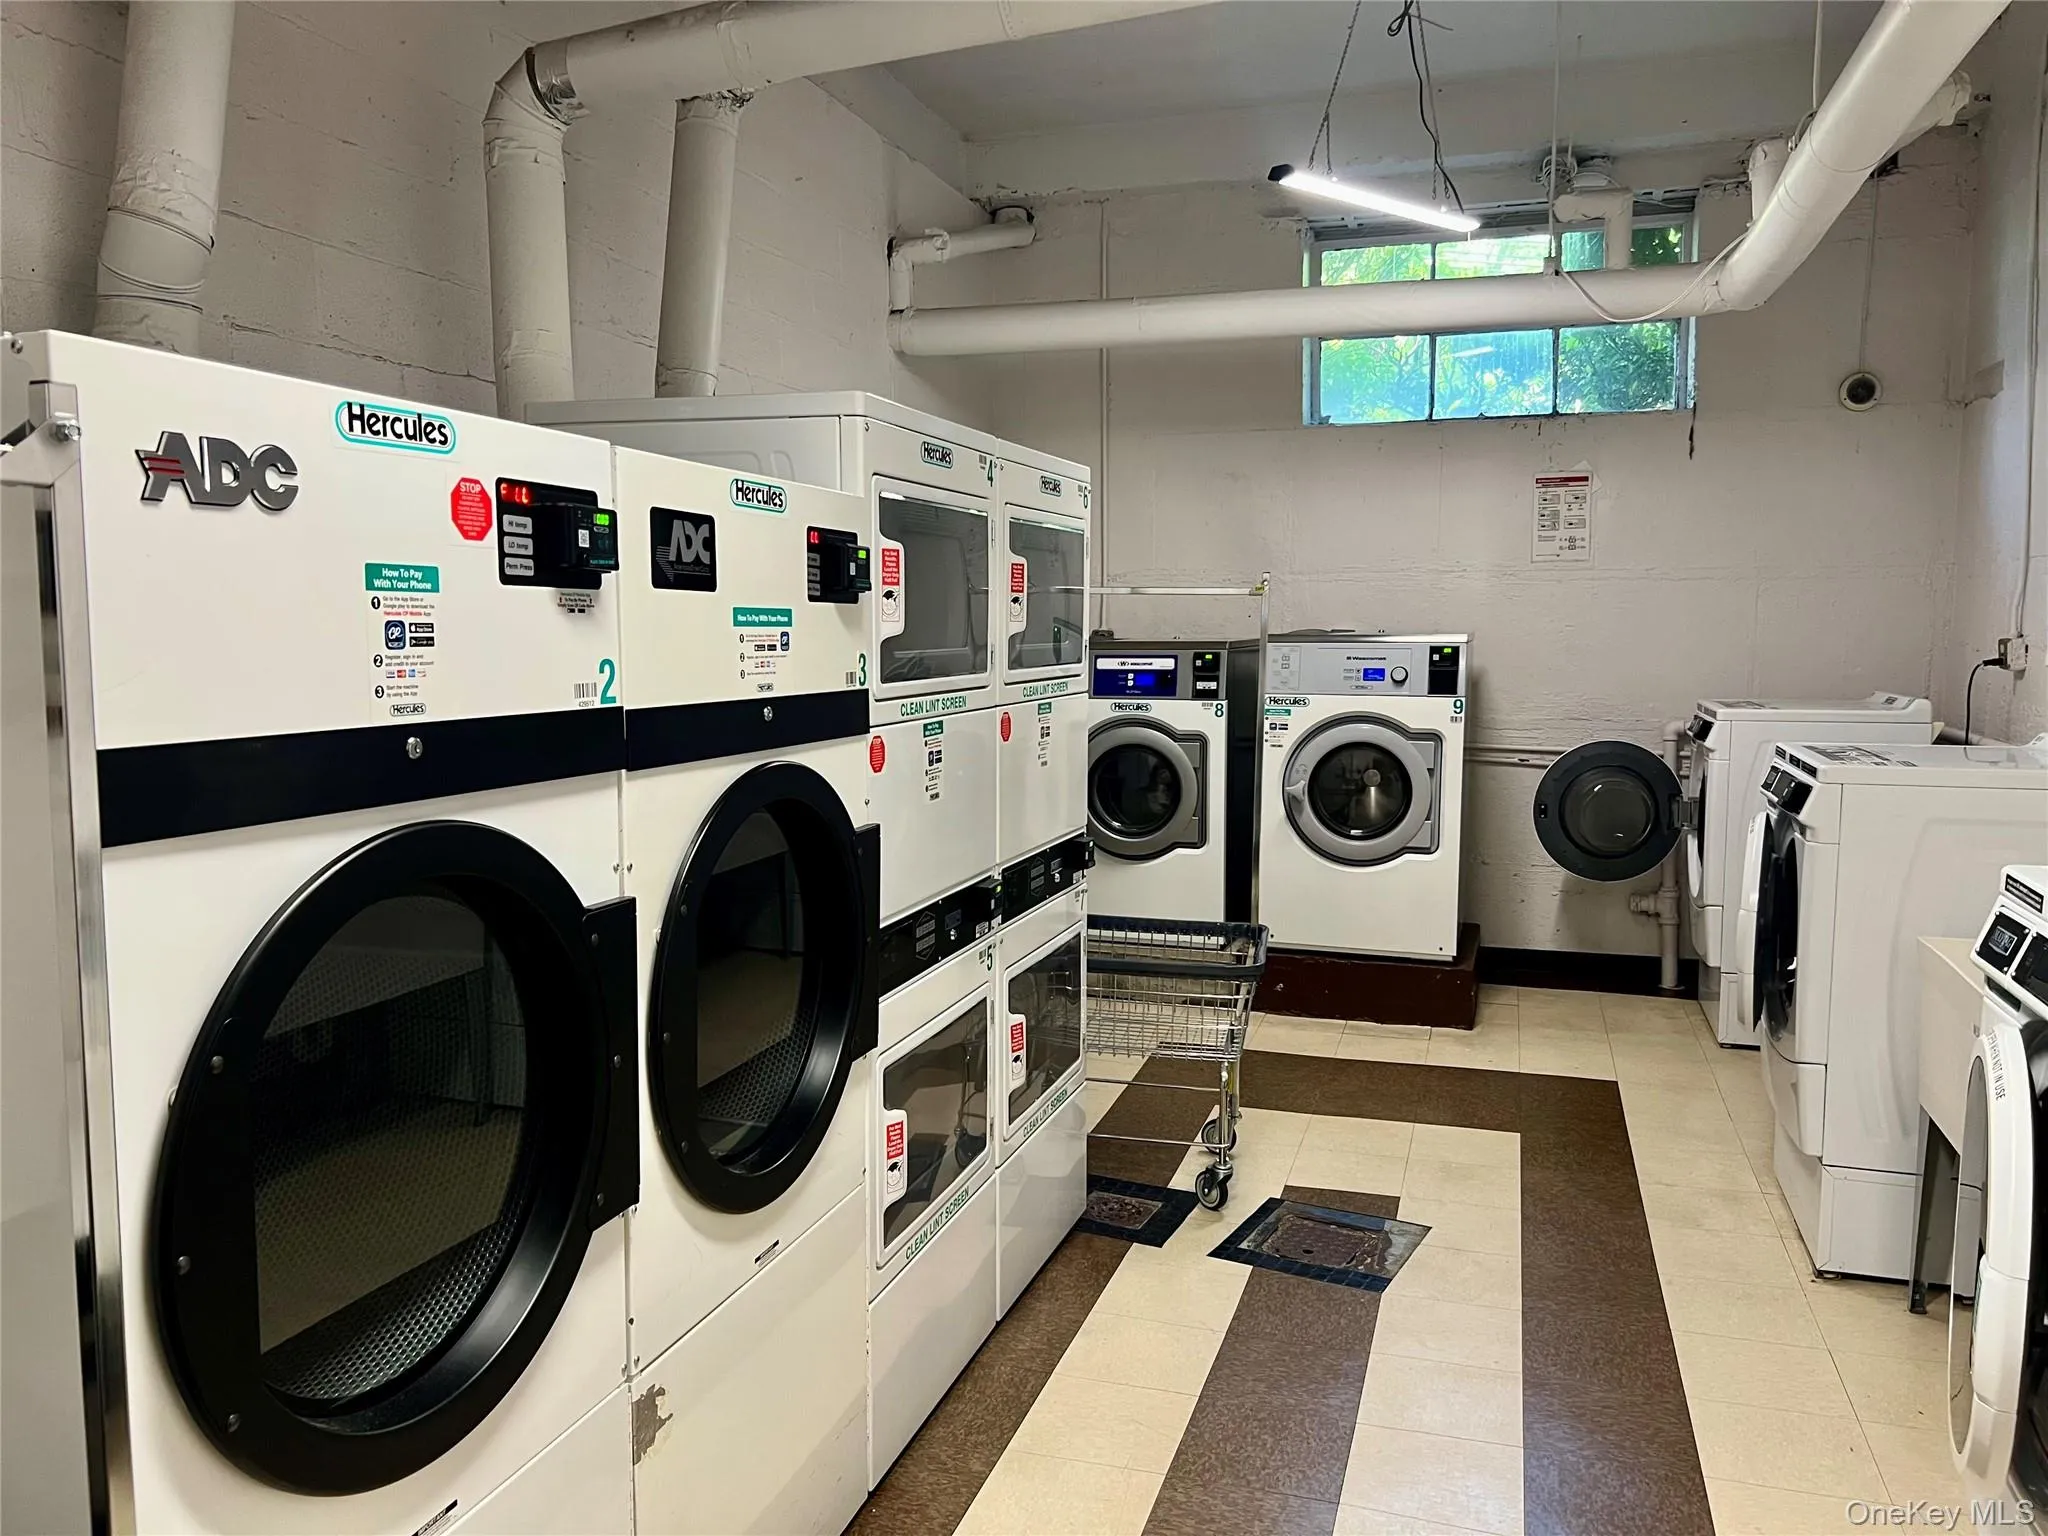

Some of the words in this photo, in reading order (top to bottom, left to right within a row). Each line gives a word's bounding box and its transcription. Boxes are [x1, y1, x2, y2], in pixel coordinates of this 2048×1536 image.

[346, 401, 449, 446] Hercules
[923, 441, 952, 465] Hercules
[135, 431, 299, 511] ADC
[987, 459, 994, 487] 4
[460, 482, 481, 494] STOP
[735, 479, 784, 509] Hercules
[1041, 476, 1061, 494] Hercules
[1083, 486, 1088, 509] 6
[669, 519, 710, 565] ADC
[382, 568, 399, 577] How
[400, 569, 409, 578] To
[410, 570, 422, 580] Pay
[506, 562, 518, 570] Perm
[520, 563, 533, 571] Press
[373, 579, 392, 588] With
[392, 580, 409, 589] Your
[410, 580, 432, 590] Phone
[858, 653, 866, 686] 3
[599, 658, 616, 704] 2
[1023, 685, 1038, 698] CLEAN
[1040, 684, 1050, 695] LINT
[1050, 681, 1068, 694] SCREEN
[392, 704, 424, 714] Hercules
[900, 701, 923, 716] CLEAN
[926, 699, 940, 713] LINT
[942, 696, 966, 710] SCREEN
[1113, 703, 1149, 712] Hercules
[1214, 702, 1224, 718] 8
[1268, 696, 1307, 706] Hercules
[1453, 698, 1464, 714] 9
[986, 944, 993, 971] 5
[1992, 1059, 2003, 1074] NOT
[1994, 1083, 2006, 1101] USE
[1024, 1115, 1038, 1138] CLEAN
[1040, 1104, 1050, 1122] LINT
[906, 1228, 928, 1260] CLEAN
[930, 1212, 944, 1236] LINT
[944, 1186, 970, 1219] SCREEN
